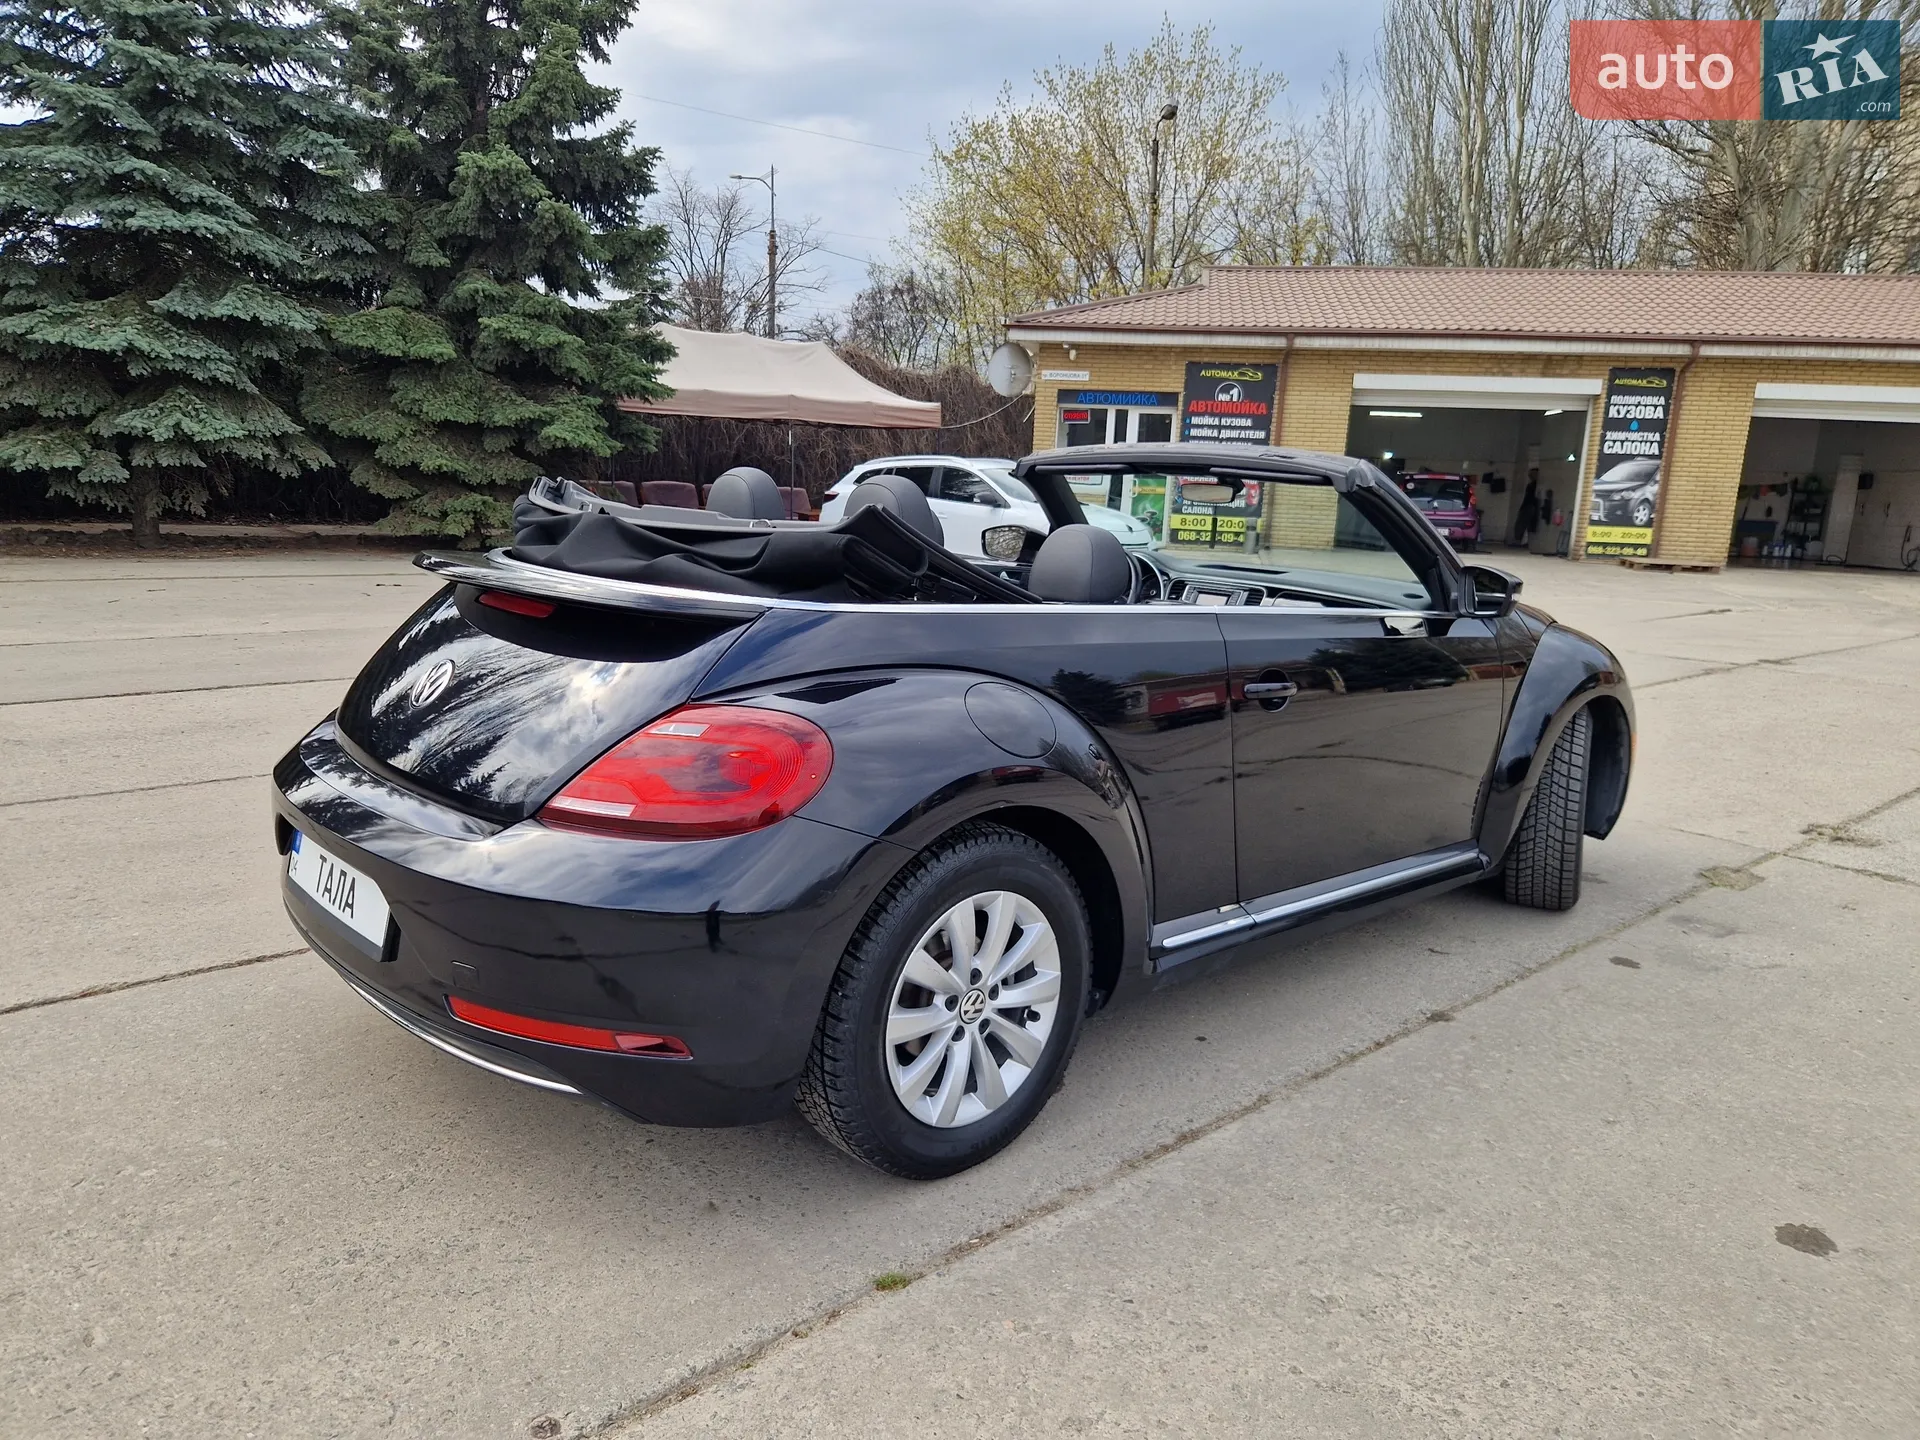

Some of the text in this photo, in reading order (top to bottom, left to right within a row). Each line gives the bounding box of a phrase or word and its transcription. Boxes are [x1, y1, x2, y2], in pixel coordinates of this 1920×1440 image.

[1200, 369, 1239, 378] AUTOMAX
[1077, 392, 1158, 406] АВТОМИЙКА
[1610, 394, 1666, 406] ПОЛИРОВКА
[1188, 398, 1268, 415] АВТОМОЙКА
[1608, 405, 1665, 420] КУЗОВА
[1191, 415, 1253, 427] МОЙКА КУЗОВА
[1189, 427, 1266, 440] МОЙКА ДВИГАТЕЛЯ
[1605, 430, 1661, 442] ХИМЧИСТКА
[1603, 440, 1660, 456] САЛОНА
[1182, 505, 1213, 515] САЛОНА
[1180, 517, 1245, 529] 8:00 20:0
[316, 853, 356, 920] ТАЛА
